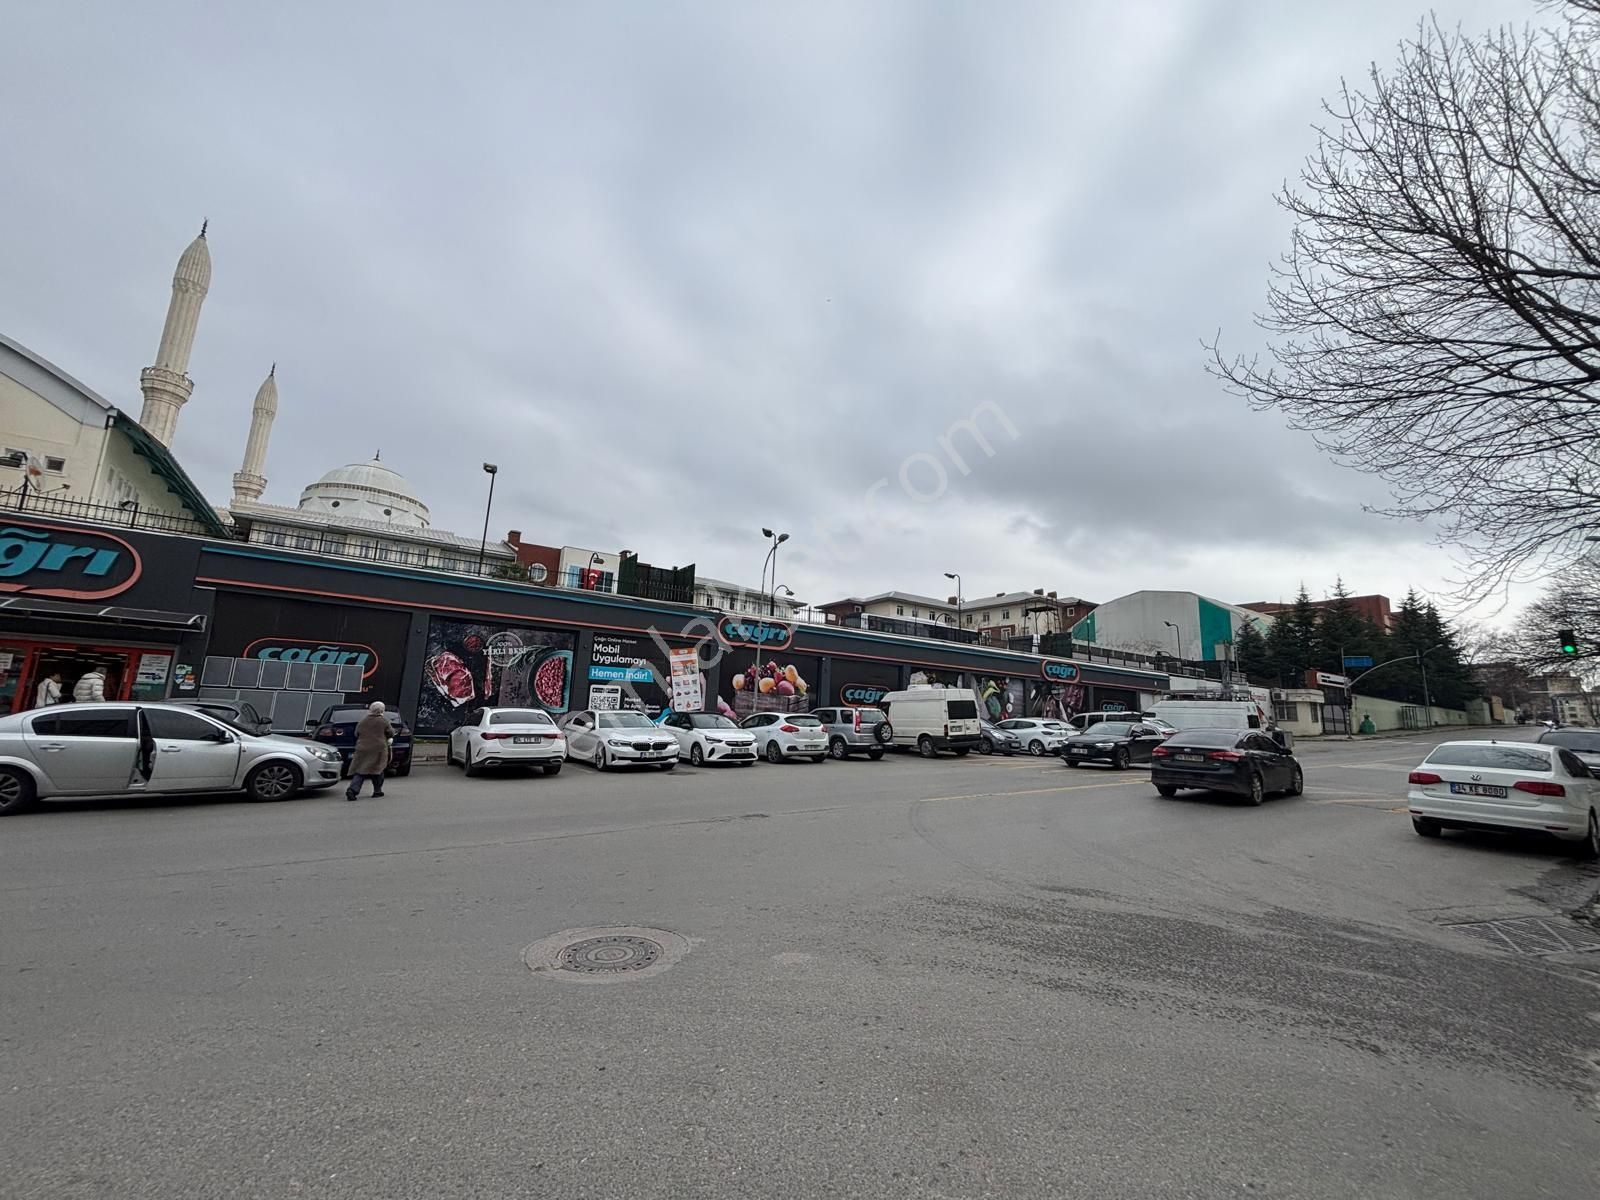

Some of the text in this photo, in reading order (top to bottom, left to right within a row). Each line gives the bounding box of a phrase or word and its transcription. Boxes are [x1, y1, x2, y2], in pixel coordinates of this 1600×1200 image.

[0, 527, 120, 577] ğrı
[593, 643, 620, 653] Mobil
[592, 653, 647, 666] Uygulamayı
[591, 668, 624, 678] Hemen
[1456, 784, 1467, 793] 34
[1469, 785, 1481, 794] KE
